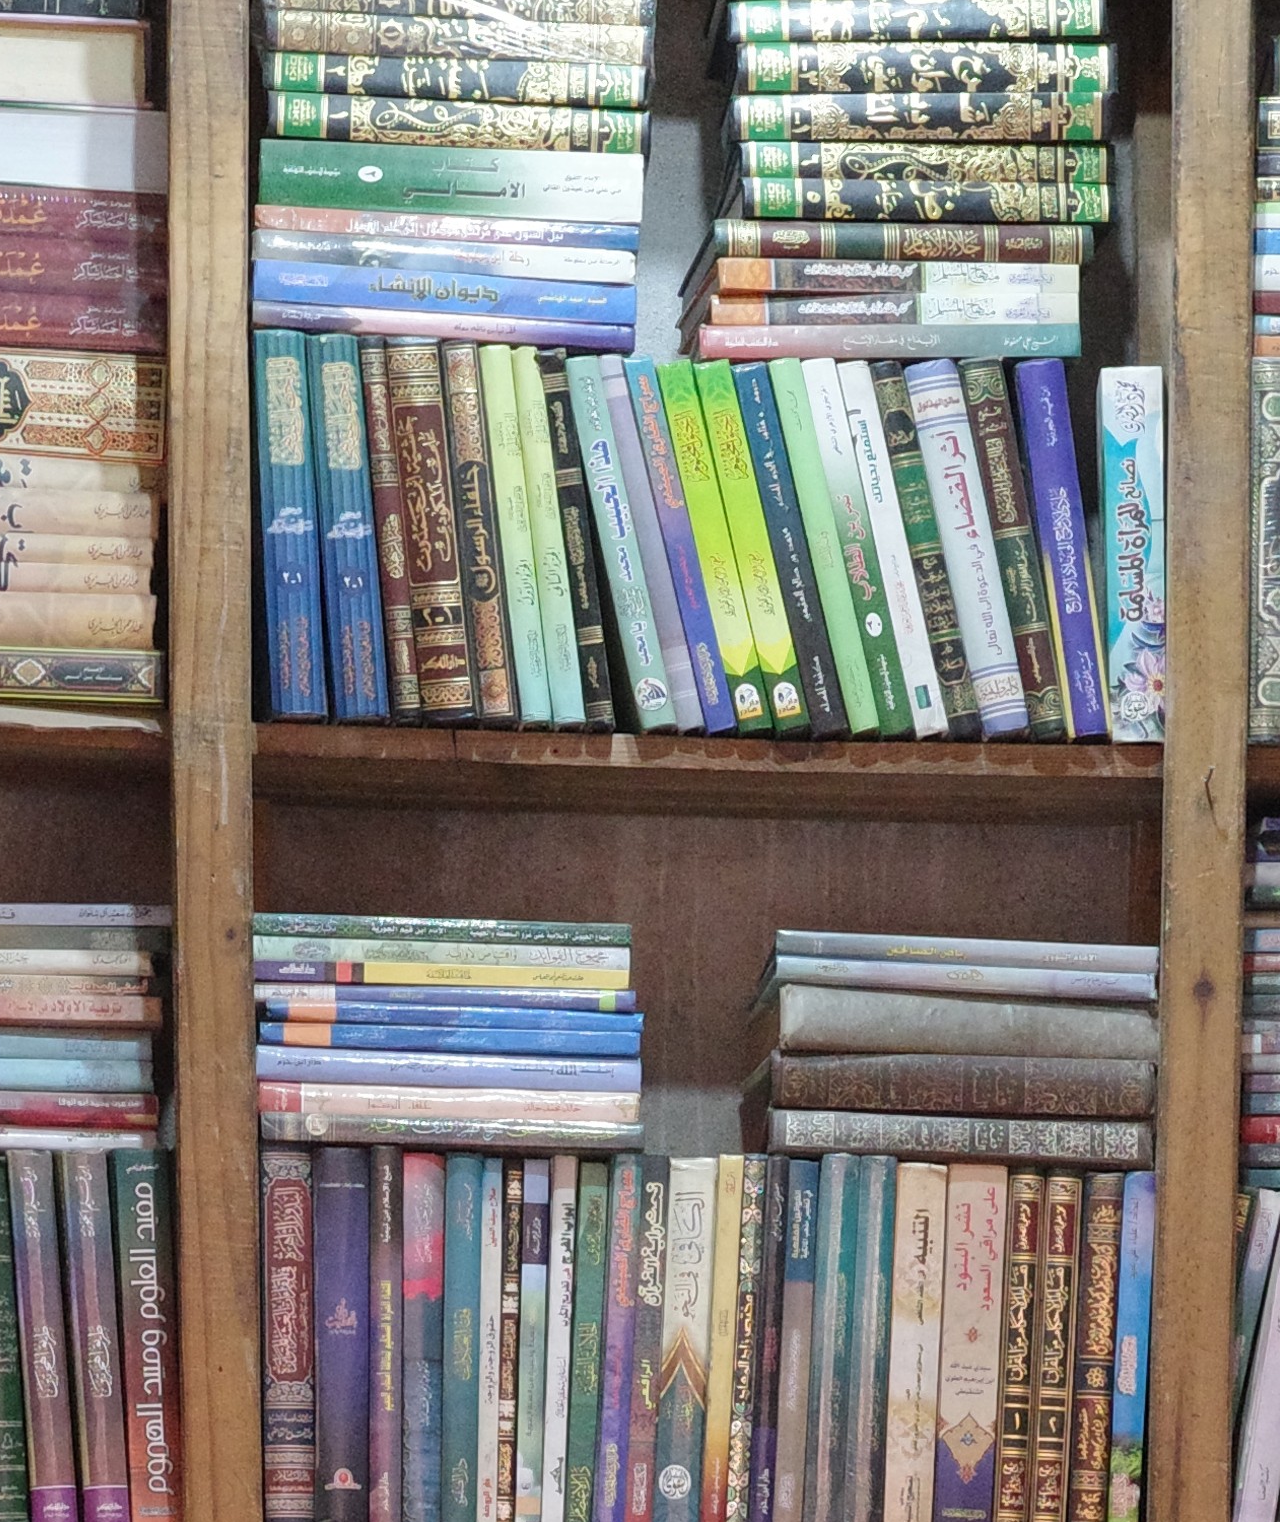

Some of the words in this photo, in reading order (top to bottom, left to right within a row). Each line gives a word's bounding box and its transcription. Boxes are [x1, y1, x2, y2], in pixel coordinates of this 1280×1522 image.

[432, 157, 499, 174] كتاب
[403, 181, 526, 201] الأمالي
[369, 275, 432, 300] الإنشاء
[434, 282, 498, 302] ديوان
[637, 375, 658, 413] سراج
[589, 439, 619, 474] هذا
[857, 421, 879, 462] استمتع
[464, 464, 487, 518] خلفاء
[867, 464, 884, 503] بحياتك
[595, 477, 628, 540] الحبيب
[469, 518, 496, 571] الرسول
[616, 547, 634, 582] محمد
[845, 544, 875, 601] الطلاب
[132, 1182, 154, 1240] مفيد
[640, 1183, 662, 1222] تحت
[954, 1203, 972, 1233] نشر
[983, 1187, 996, 1213] على
[672, 1192, 705, 1264] الكافي
[912, 1209, 931, 1264] التنبيه
[979, 1216, 998, 1260] مراقي
[130, 1246, 166, 1322] العلوم
[953, 1241, 972, 1291] البنود
[977, 1265, 994, 1310] السعود
[739, 1295, 756, 1329] مختصر
[140, 1330, 166, 1396] ومبيد
[137, 1403, 173, 1494] الهموم
